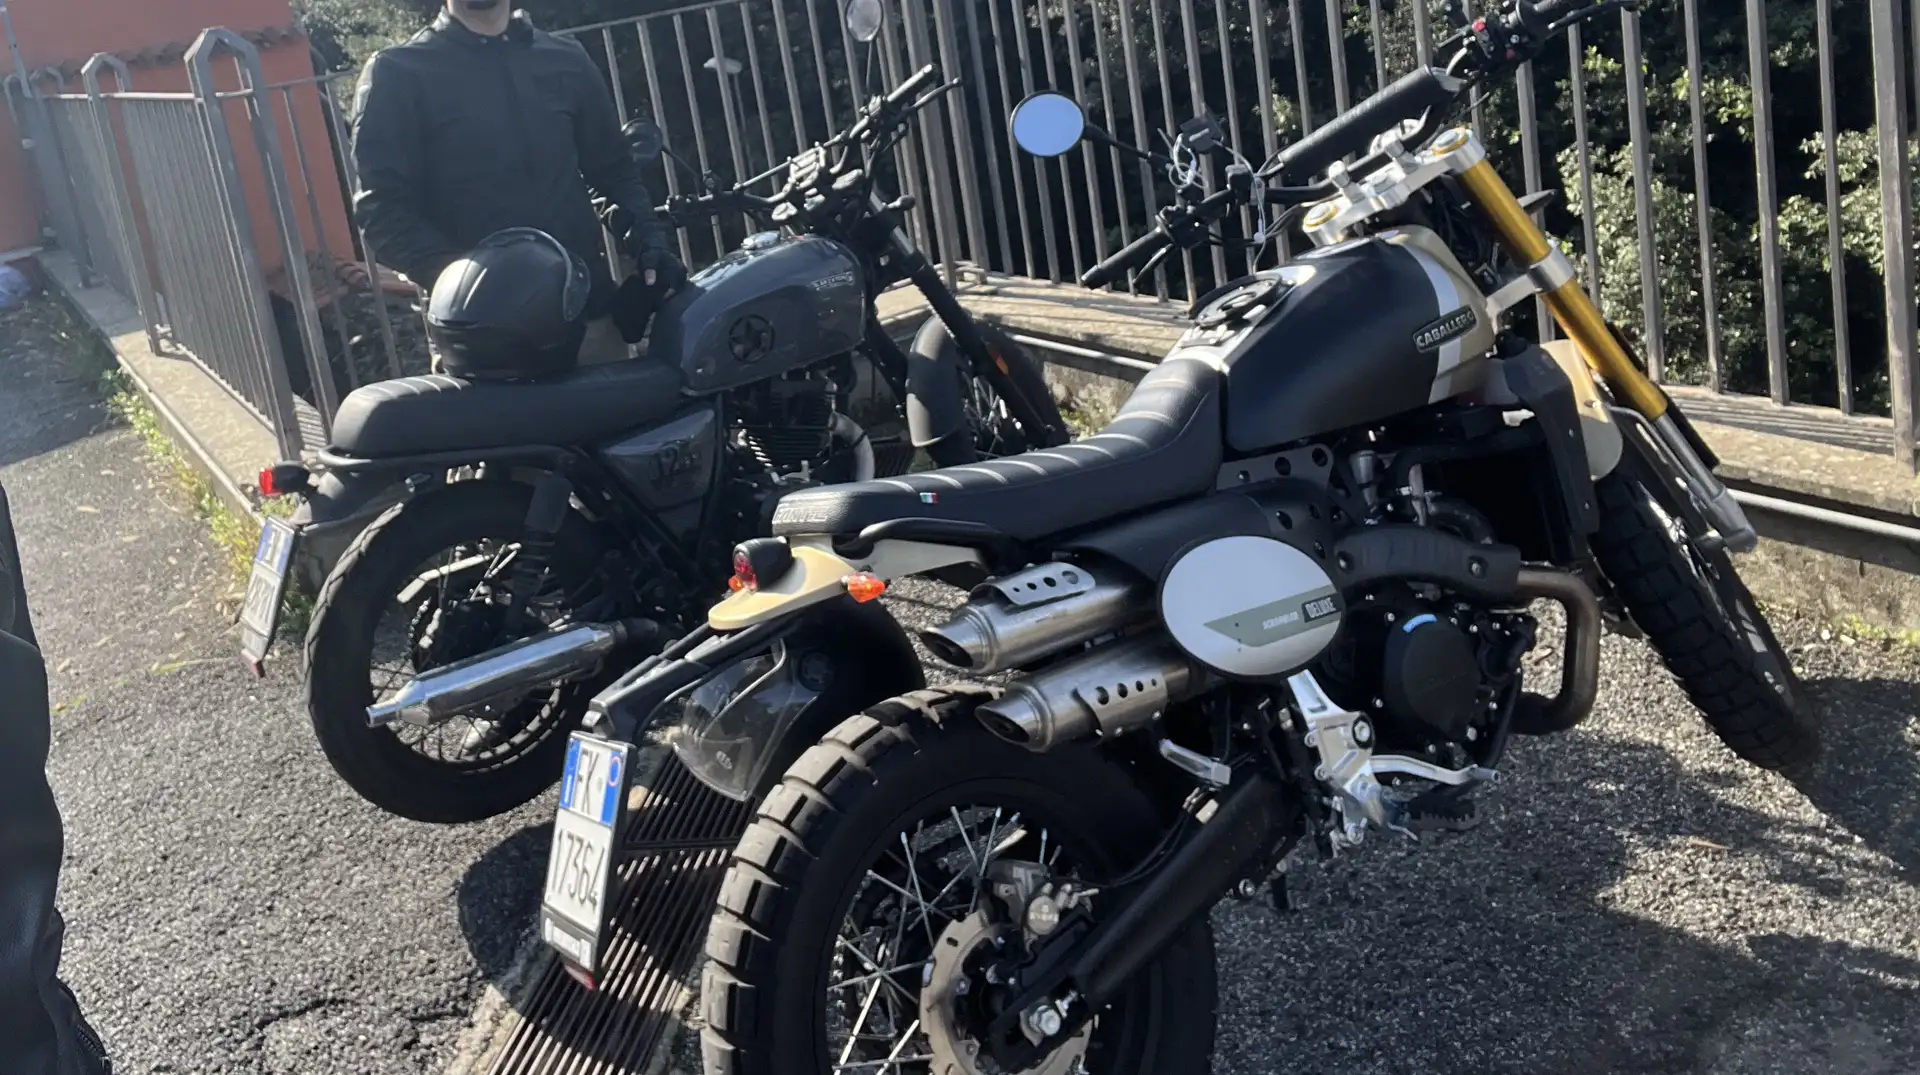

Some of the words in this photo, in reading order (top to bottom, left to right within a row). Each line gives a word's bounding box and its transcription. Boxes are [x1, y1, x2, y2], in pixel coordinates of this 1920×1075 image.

[1416, 310, 1475, 347] CABALLERO
[571, 747, 600, 815] FK
[552, 828, 606, 915] 17364
